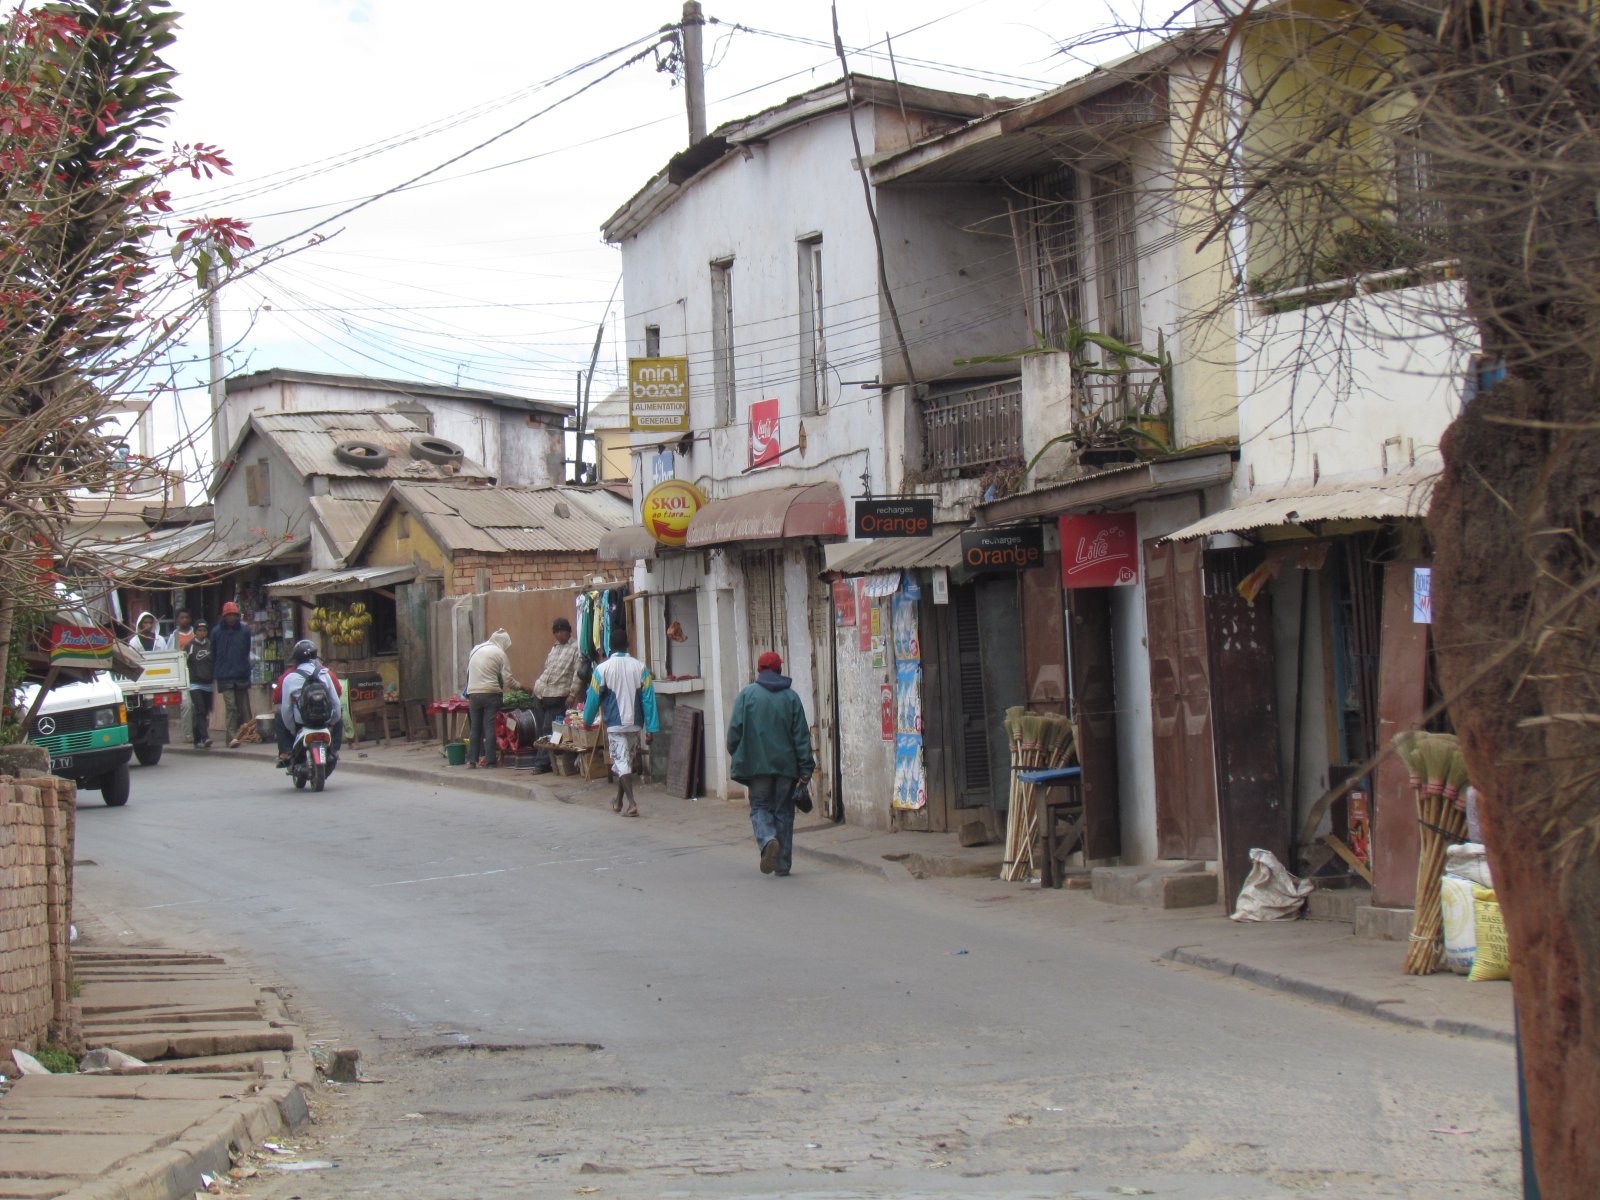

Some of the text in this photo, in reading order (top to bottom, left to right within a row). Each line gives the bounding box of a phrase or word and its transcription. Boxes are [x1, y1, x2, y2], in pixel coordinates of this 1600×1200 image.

[639, 364, 678, 381] mini
[633, 381, 685, 397] bazar
[635, 402, 685, 411] ALIMENTATION
[640, 416, 679, 425] GENERALE
[652, 496, 690, 510] SKOL
[876, 506, 914, 515] recharges
[861, 515, 928, 534] Orange
[981, 536, 1022, 546] recharges
[1076, 530, 1109, 563] Life
[967, 546, 1038, 566] Orange
[1121, 571, 1131, 579] ici
[59, 757, 70, 767] TV
[1486, 933, 1506, 944] LON
[1490, 943, 1509, 953] WH
